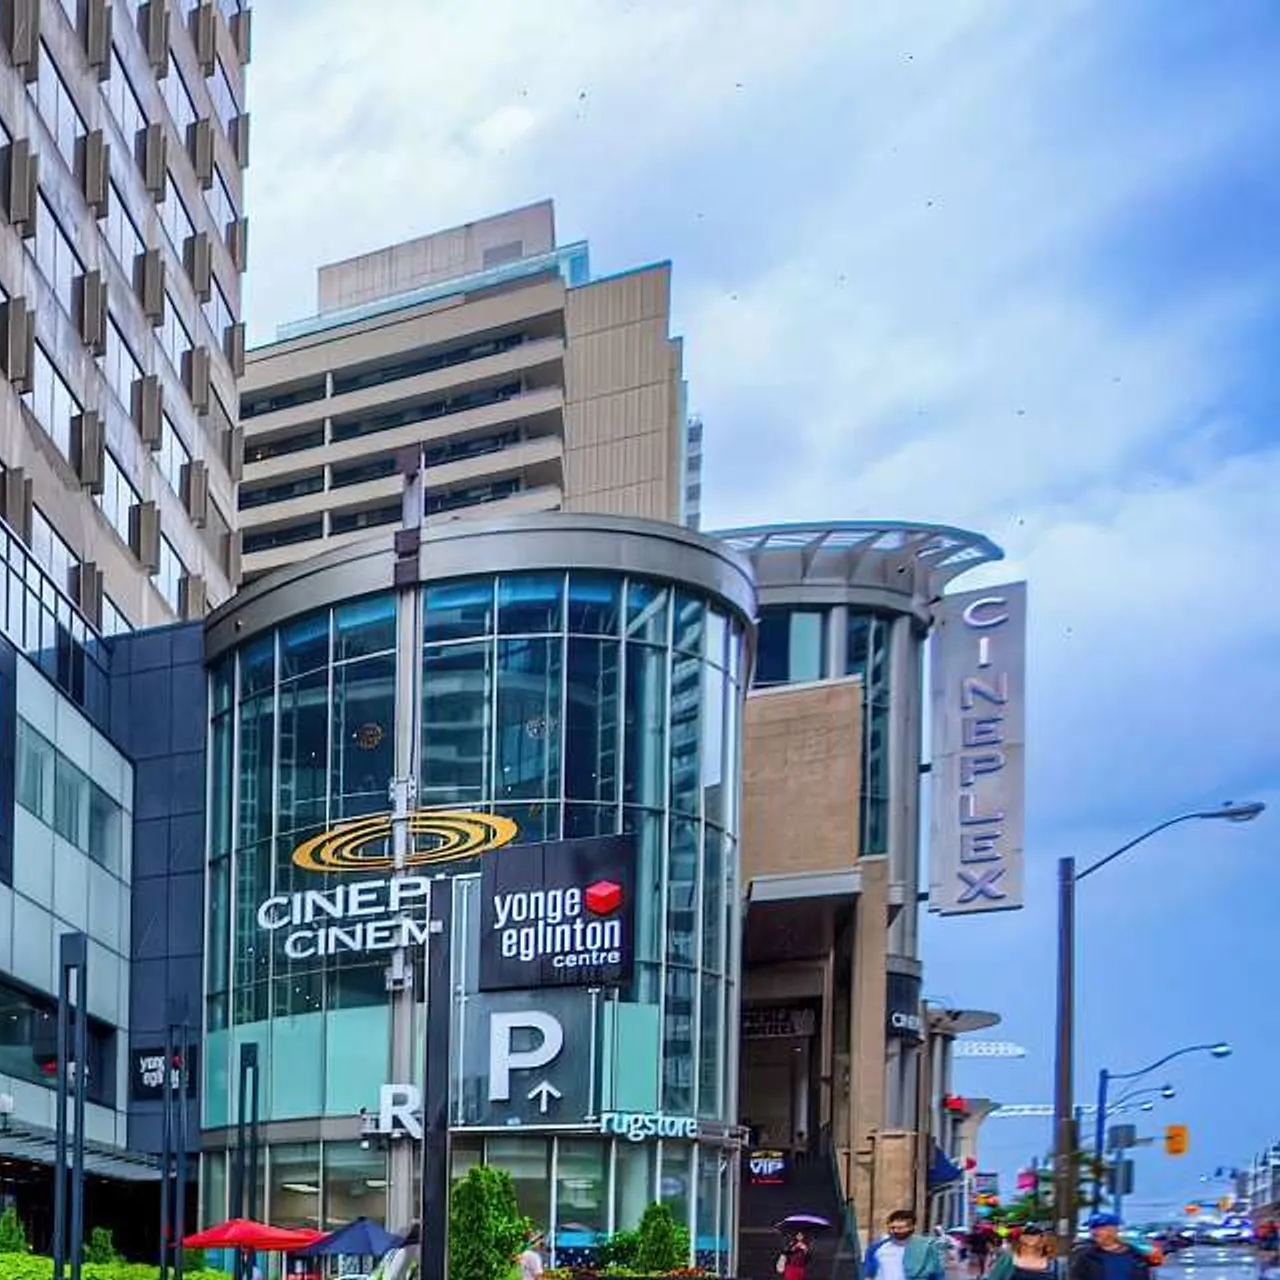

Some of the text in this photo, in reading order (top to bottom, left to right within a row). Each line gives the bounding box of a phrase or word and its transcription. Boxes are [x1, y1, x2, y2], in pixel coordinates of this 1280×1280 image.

[957, 596, 1009, 904] CINEPLEX
[494, 888, 582, 930] yonge
[502, 917, 621, 962] eglinton
[553, 950, 621, 967] centre
[490, 1010, 564, 1101] P
